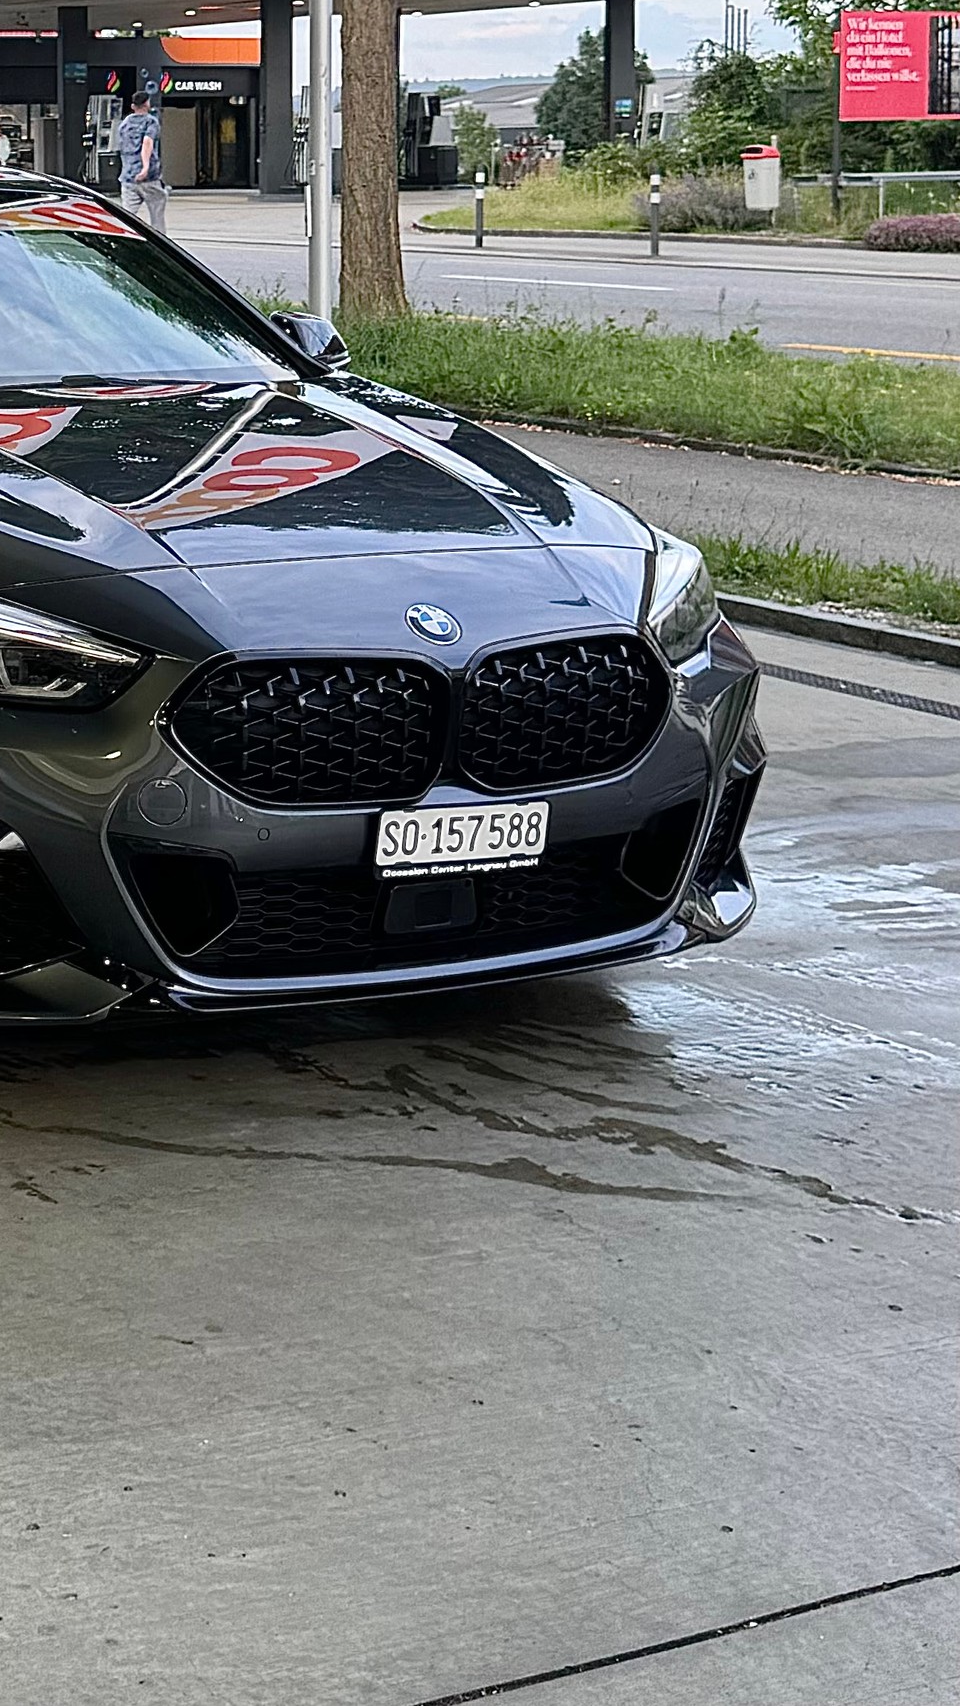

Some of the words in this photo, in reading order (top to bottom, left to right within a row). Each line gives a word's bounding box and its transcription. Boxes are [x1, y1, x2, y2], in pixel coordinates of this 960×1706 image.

[847, 17, 867, 31] Wir
[868, 17, 904, 31] kennen
[846, 30, 860, 43] da
[860, 31, 876, 43] ein
[876, 30, 903, 43] Hotel
[846, 44, 864, 56] mit
[846, 57, 862, 69] die
[862, 57, 876, 69] du
[876, 57, 893, 69] nie
[846, 69, 891, 82] verlassen
[175, 81, 194, 91] CAR
[194, 81, 222, 91] WASH
[382, 867, 428, 878] Occasion
[430, 864, 464, 874] Center
[509, 857, 539, 868] GmbH
